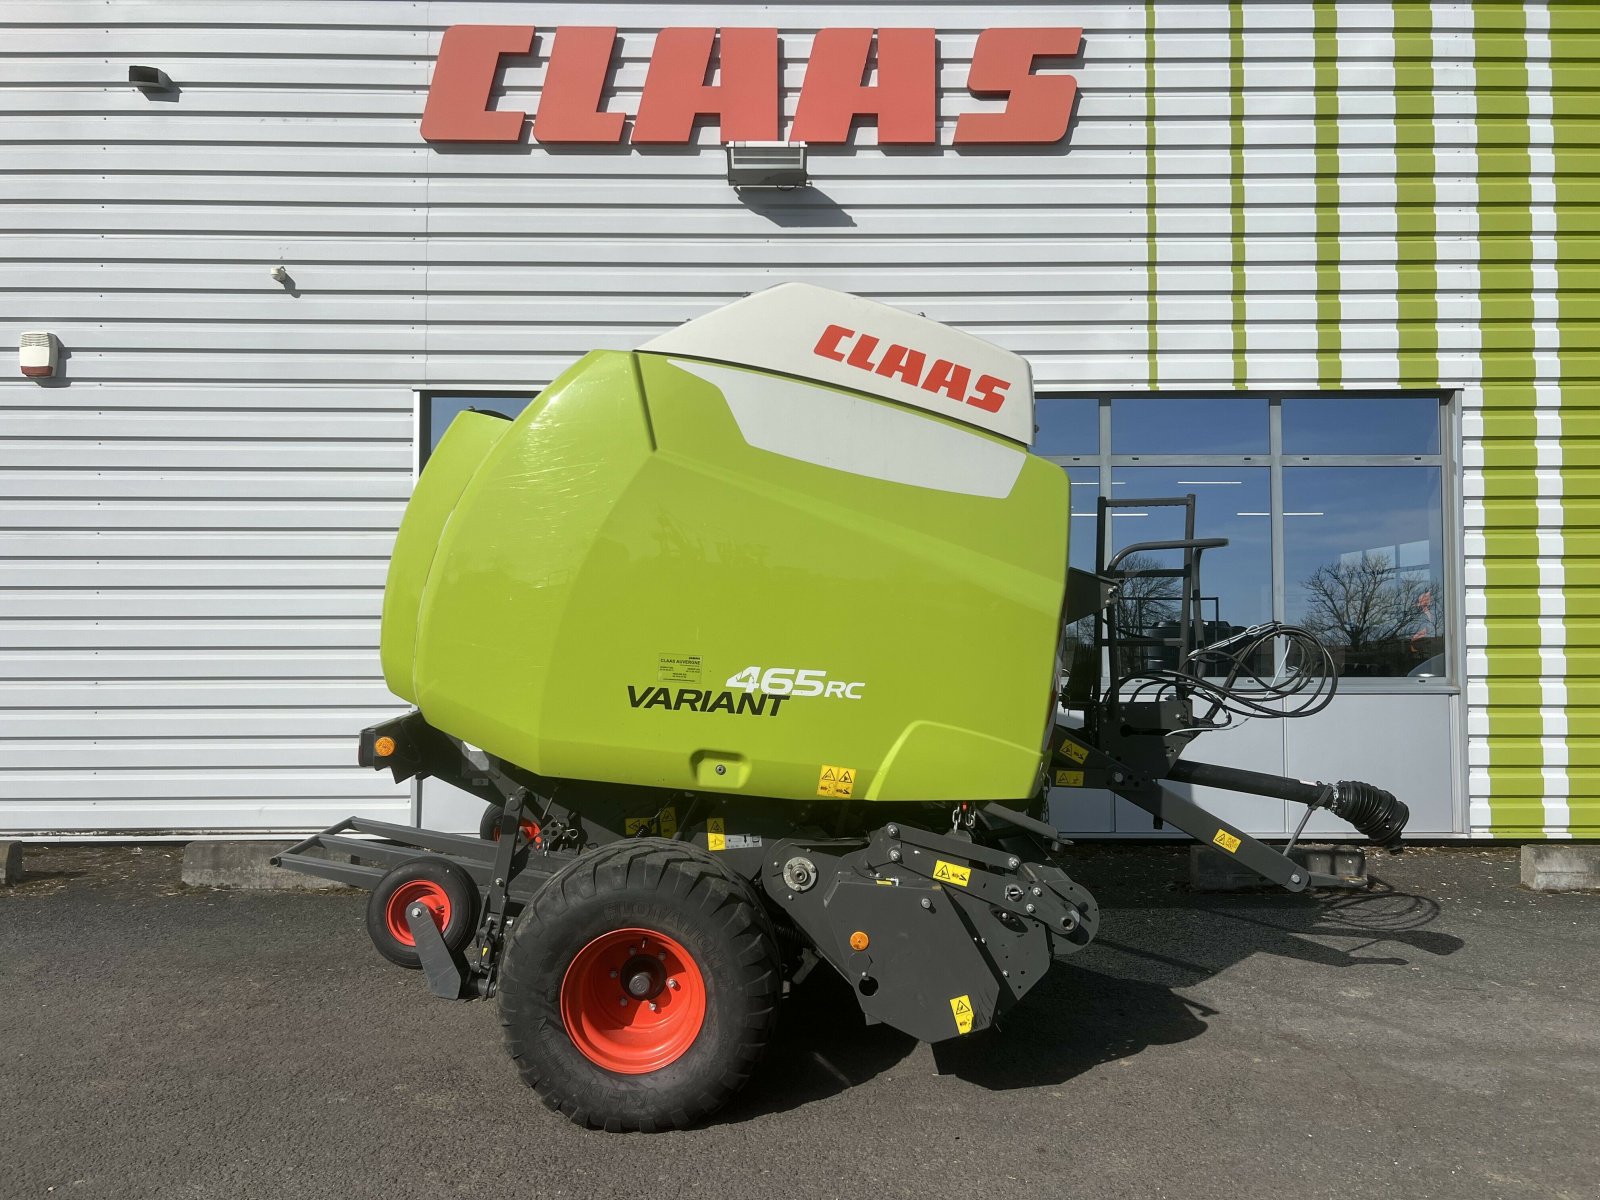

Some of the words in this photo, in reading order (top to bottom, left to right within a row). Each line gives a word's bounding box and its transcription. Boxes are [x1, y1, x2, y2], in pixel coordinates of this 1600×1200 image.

[420, 25, 1082, 143] CLAAS
[814, 324, 1011, 413] CLAAS
[627, 685, 790, 716] VARIANT
